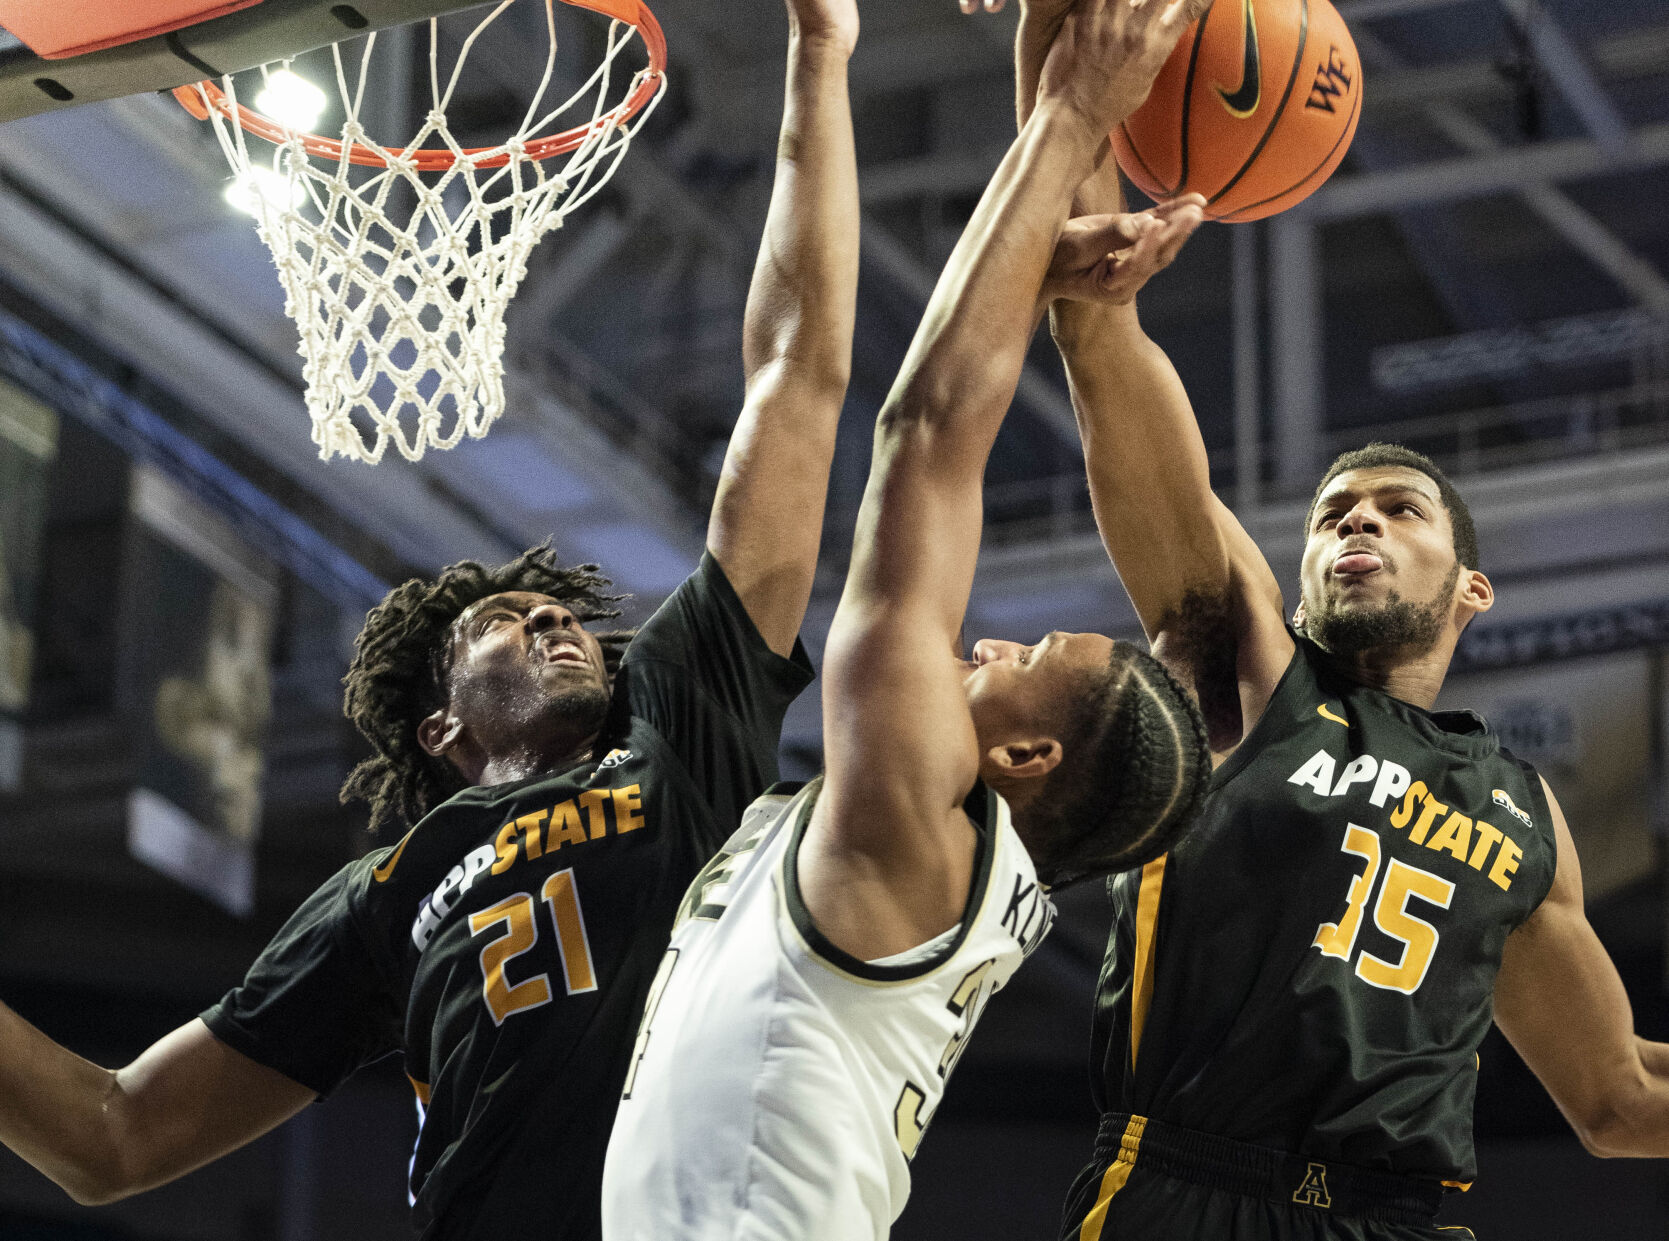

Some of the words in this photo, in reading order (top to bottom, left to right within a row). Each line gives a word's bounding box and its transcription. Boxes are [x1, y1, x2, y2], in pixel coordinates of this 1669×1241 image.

[1304, 43, 1352, 115] WF
[467, 866, 599, 1028] 21
[1292, 1162, 1332, 1208] A
